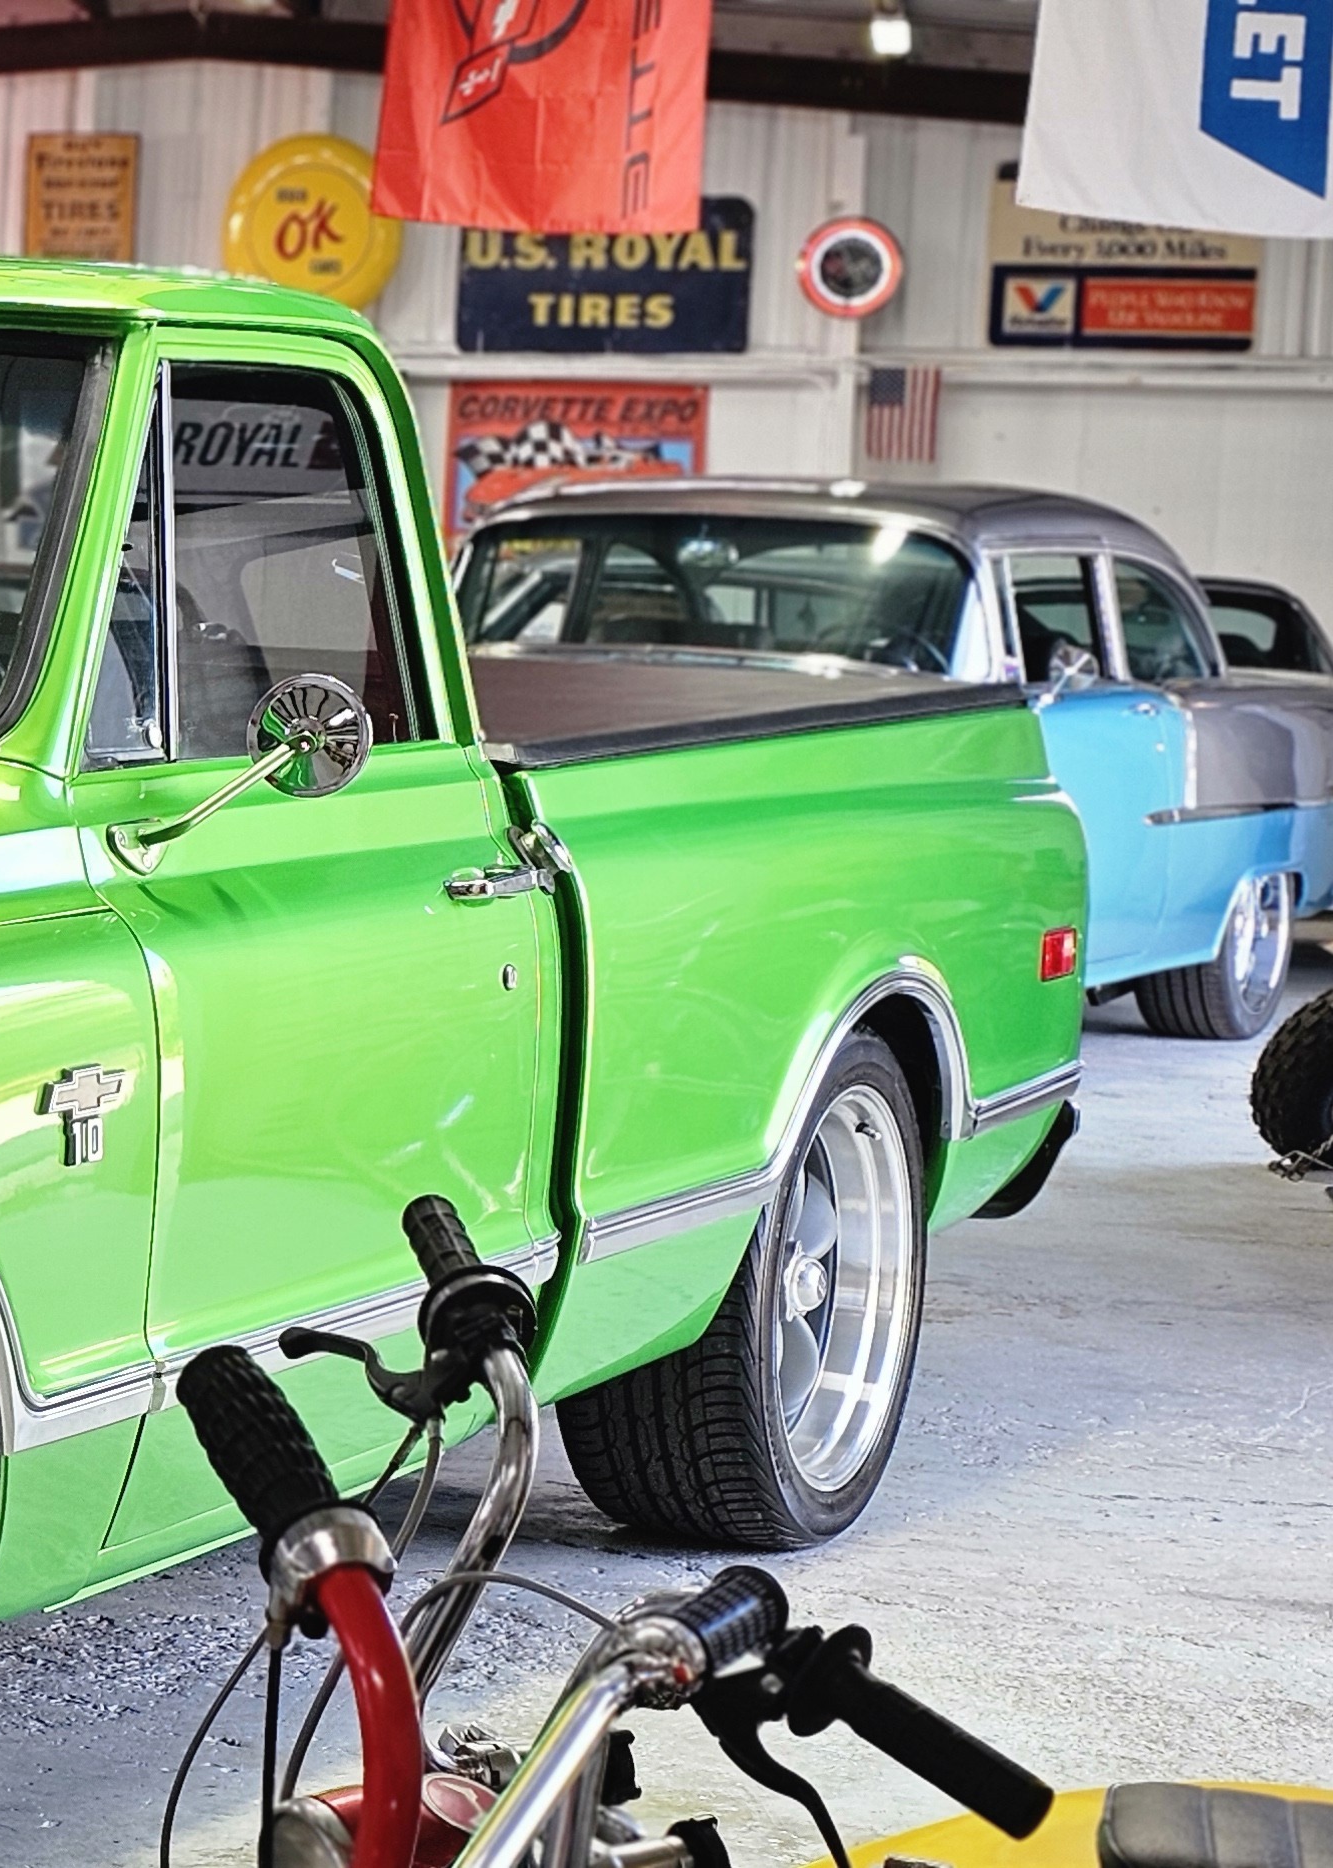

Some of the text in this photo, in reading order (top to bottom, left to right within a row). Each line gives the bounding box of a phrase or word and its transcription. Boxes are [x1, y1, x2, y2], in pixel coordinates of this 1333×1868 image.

[1230, 0, 1306, 121] ET
[274, 199, 343, 262] OK
[464, 229, 747, 271] U.S. ROYAL
[527, 292, 675, 329] TIRES
[458, 394, 699, 423] CORVETTE EXPO
[173, 421, 302, 468] ROYAL
[68, 1117, 103, 1166] 10
